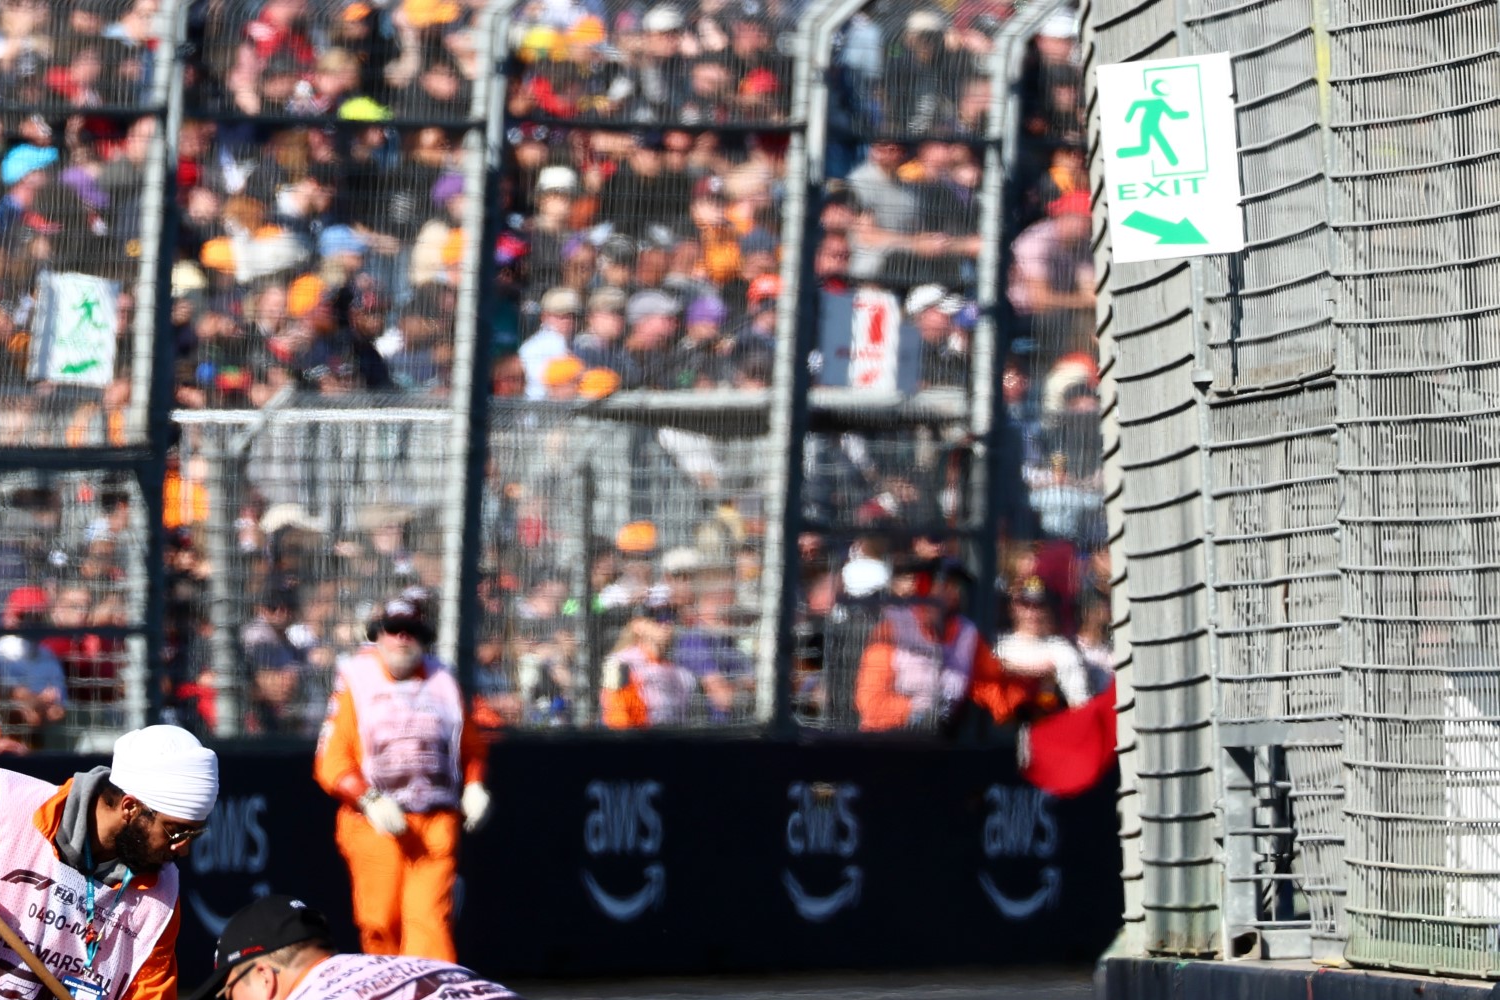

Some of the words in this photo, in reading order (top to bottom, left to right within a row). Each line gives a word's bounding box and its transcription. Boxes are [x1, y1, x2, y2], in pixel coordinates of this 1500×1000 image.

[1117, 177, 1207, 200] EXIT
[583, 780, 663, 855] aws
[984, 784, 1057, 857] aws
[28, 902, 102, 951] 0490-M
